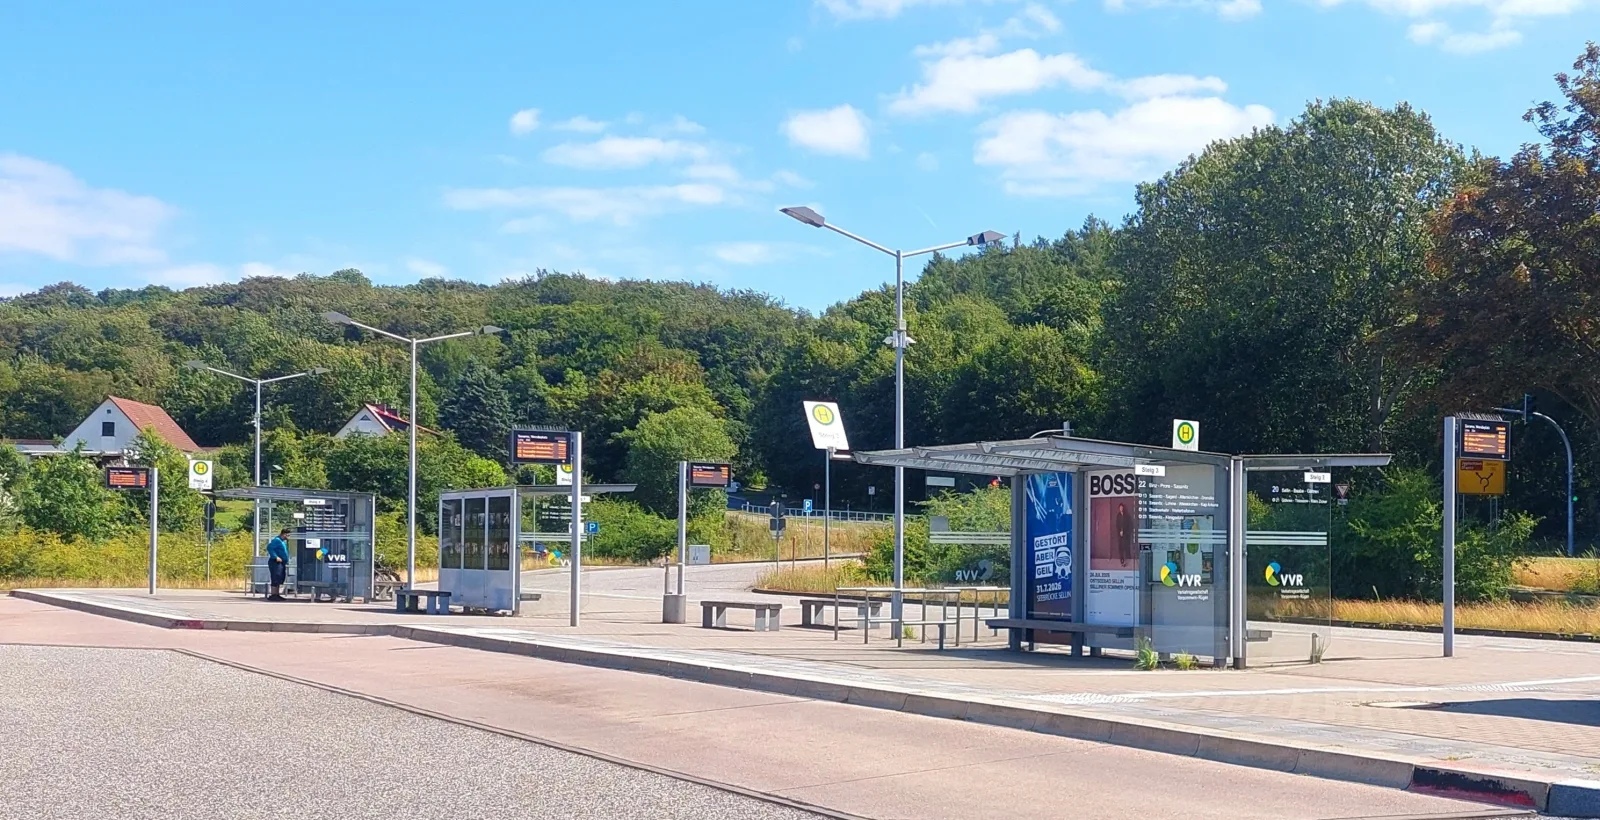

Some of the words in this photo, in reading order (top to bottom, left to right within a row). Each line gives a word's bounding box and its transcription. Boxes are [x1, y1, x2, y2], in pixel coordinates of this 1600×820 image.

[1182, 427, 1190, 439] H
[1090, 473, 1135, 495] BOSS
[1272, 485, 1279, 493] 20
[806, 501, 811, 510] P
[589, 523, 596, 532] P
[327, 554, 346, 562] VVR
[1036, 551, 1054, 562] ABER
[560, 559, 572, 567] VV
[1036, 566, 1052, 576] GEIL
[1176, 574, 1202, 587] VVR
[1280, 574, 1304, 587] VVR
[1036, 582, 1062, 594] 31.7.2026
[1058, 590, 1072, 599] SELLIN
